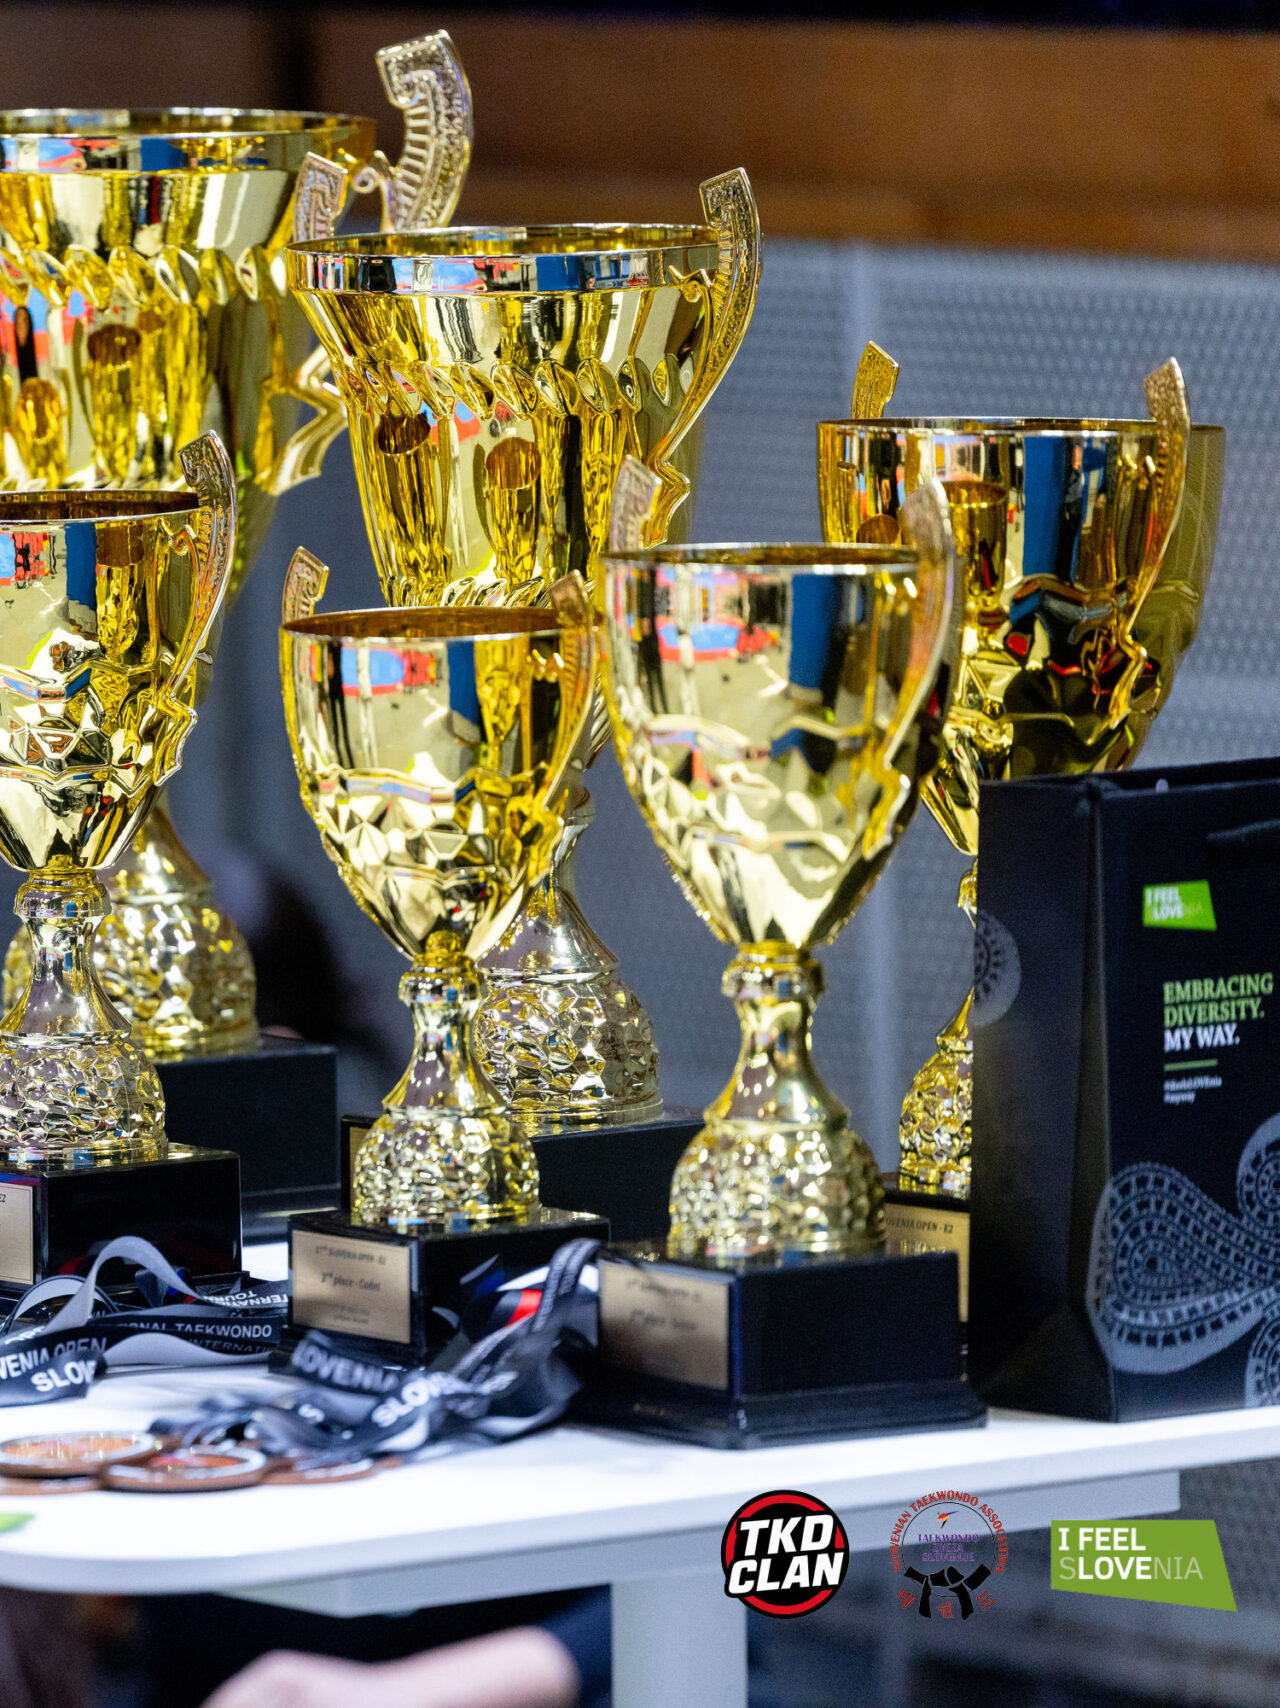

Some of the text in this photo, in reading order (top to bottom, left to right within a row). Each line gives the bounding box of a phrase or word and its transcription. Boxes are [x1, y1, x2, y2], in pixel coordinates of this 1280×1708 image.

[1163, 972, 1274, 1004] EMBRACING
[1164, 997, 1265, 1027] DIVERSITY.
[1164, 1023, 1240, 1053] MY WAY.
[916, 1221, 937, 1233] OPEN
[175, 1322, 273, 1339] TAEKWONDO
[31, 1359, 97, 1392] SLOV
